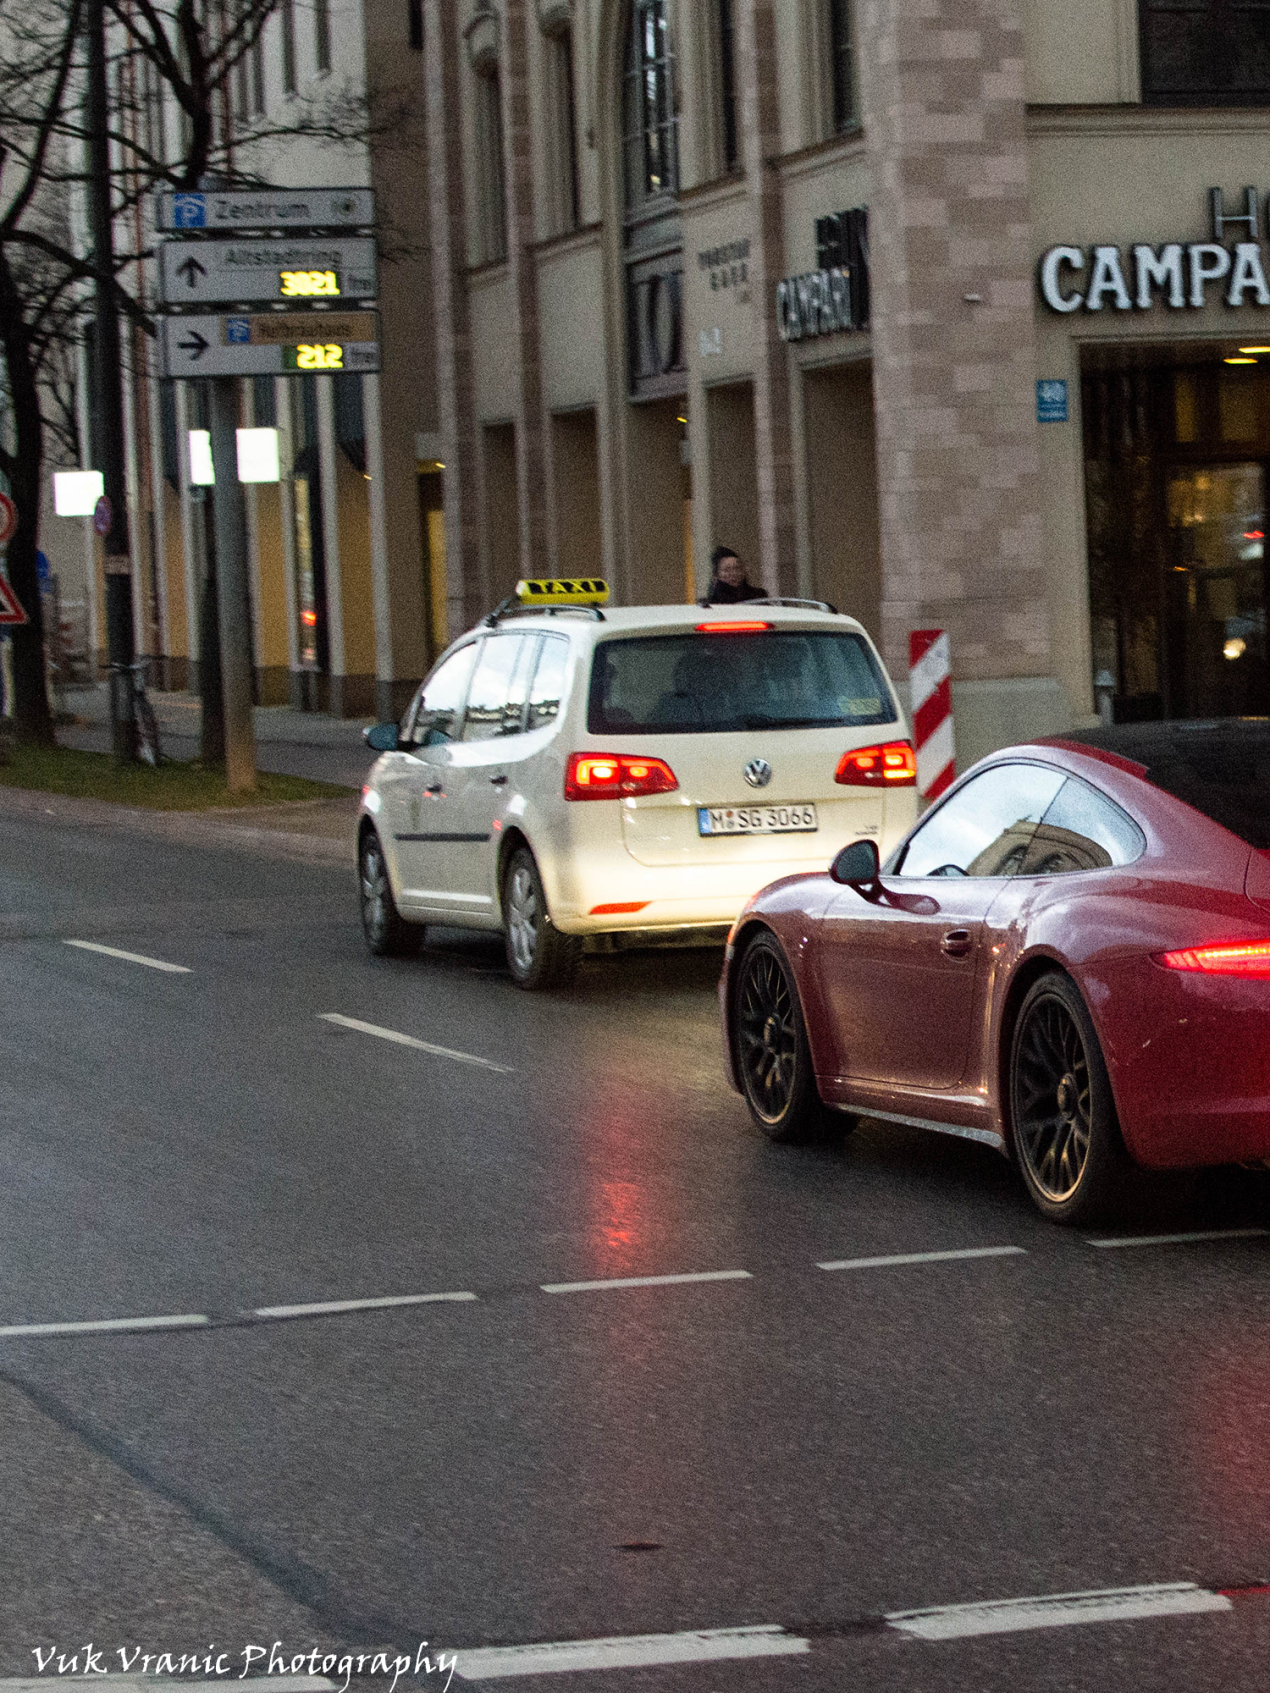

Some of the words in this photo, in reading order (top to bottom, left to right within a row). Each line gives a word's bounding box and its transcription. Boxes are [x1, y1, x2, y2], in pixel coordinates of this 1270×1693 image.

[215, 200, 312, 220] Zentrum
[225, 248, 343, 269] Altstadtring
[279, 270, 341, 297] 3021
[296, 343, 344, 369] 212
[534, 580, 598, 594] TAXI
[710, 810, 725, 829] M
[738, 810, 763, 828] SG
[767, 808, 814, 828] 3066
